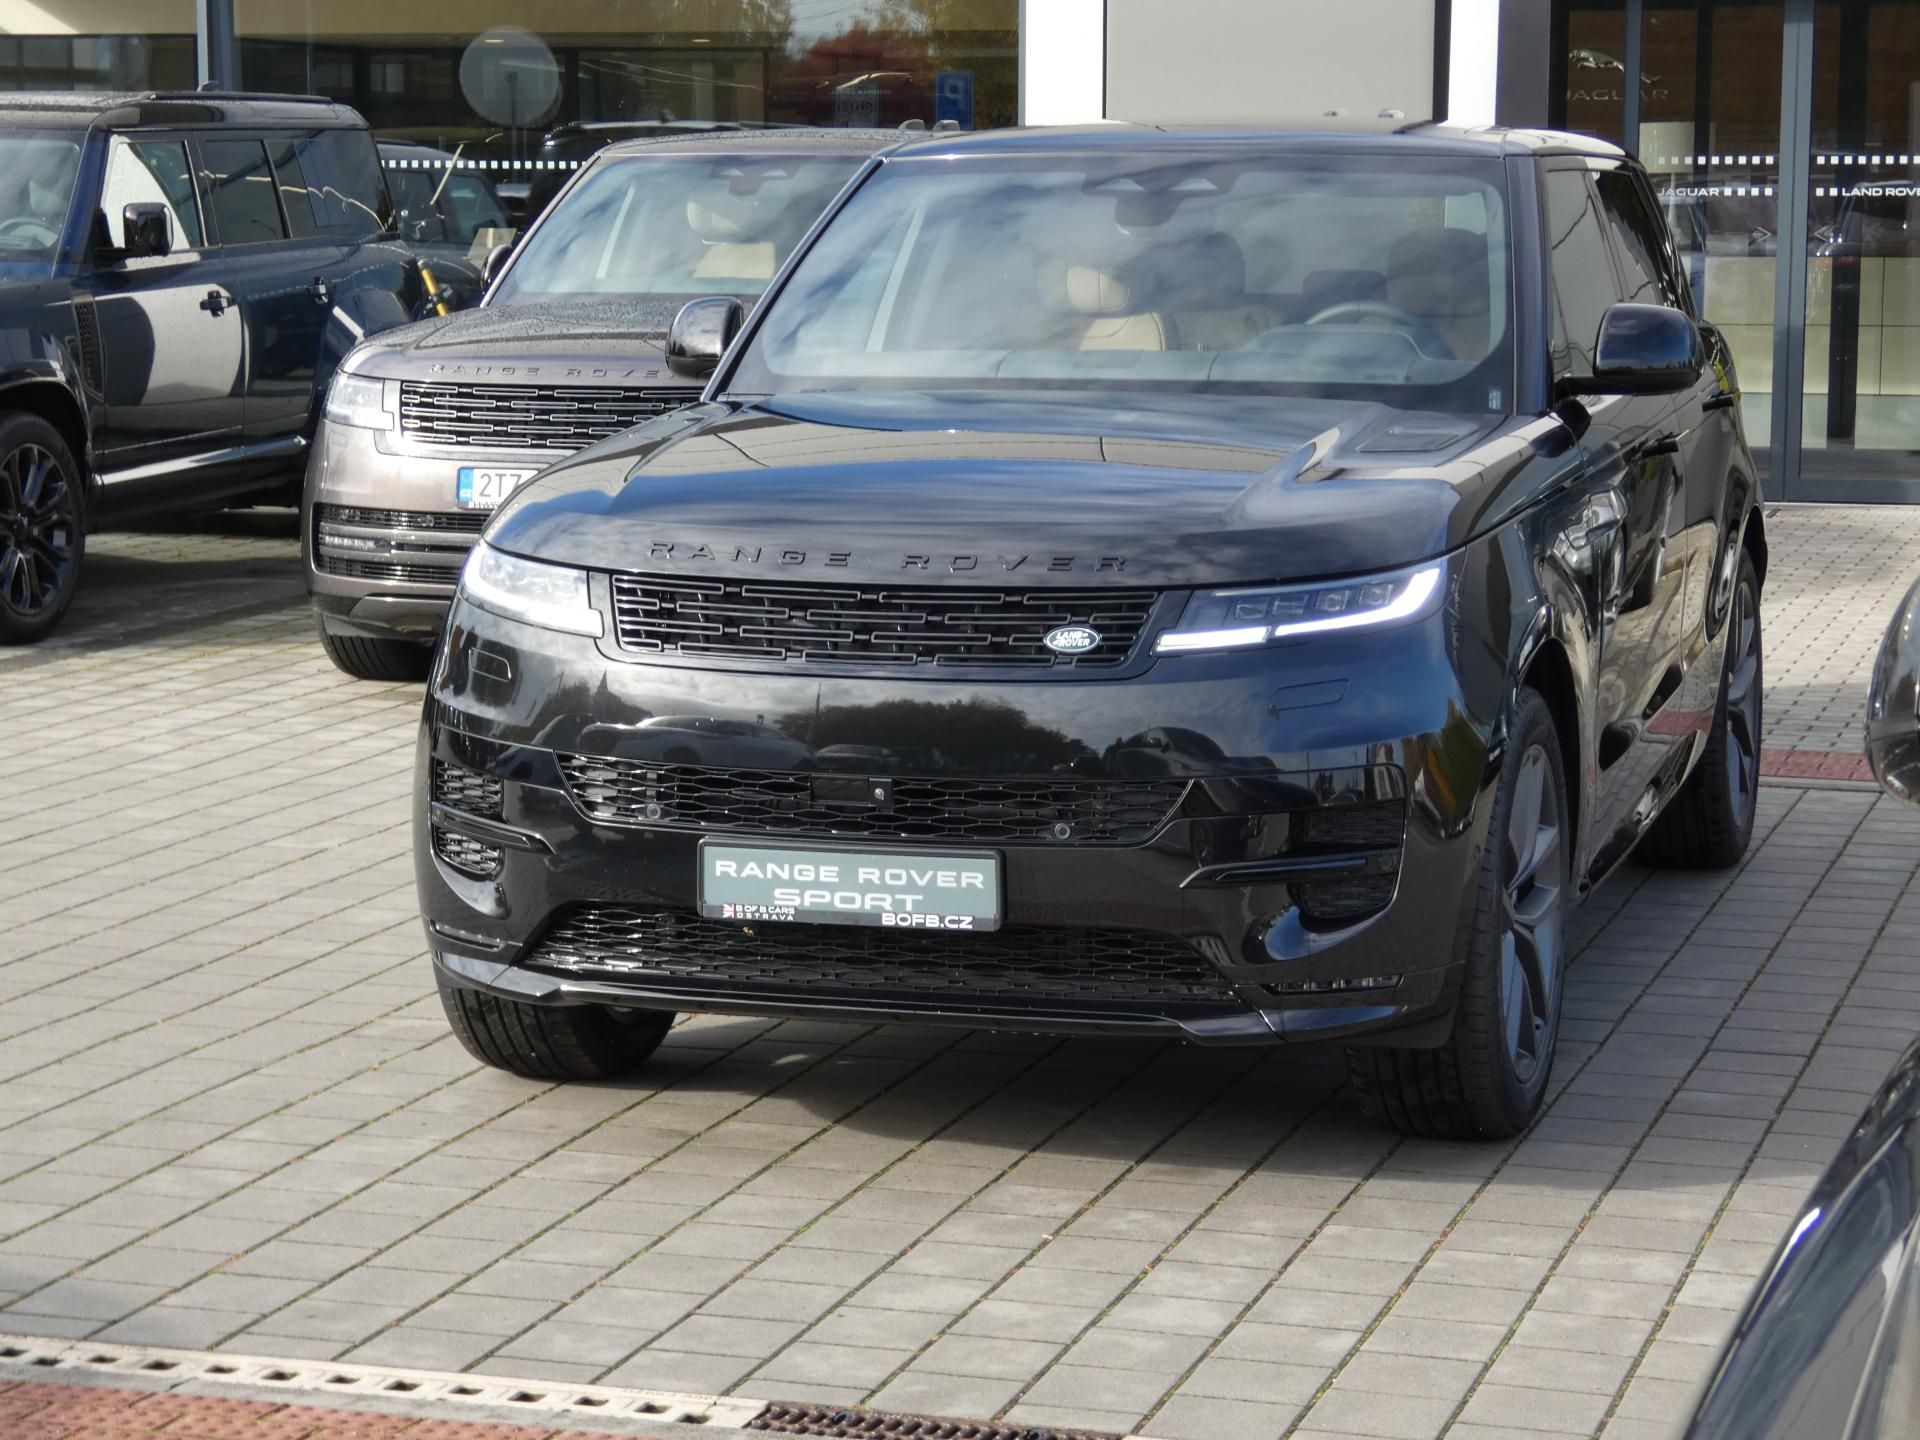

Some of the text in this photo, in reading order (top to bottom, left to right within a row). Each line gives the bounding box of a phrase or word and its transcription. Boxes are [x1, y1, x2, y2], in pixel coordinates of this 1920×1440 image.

[1657, 187, 1720, 197] JAGUAR
[1841, 187, 1883, 197] LAND
[430, 364, 675, 380] RANGE ROVE
[648, 542, 1130, 573] RANGE ROVER
[715, 860, 985, 889] RANGE ROVER
[773, 888, 923, 912] SPORT
[737, 912, 795, 921] OSTRAVA
[768, 906, 795, 915] CARS
[881, 912, 974, 930] BOFB.CZ
